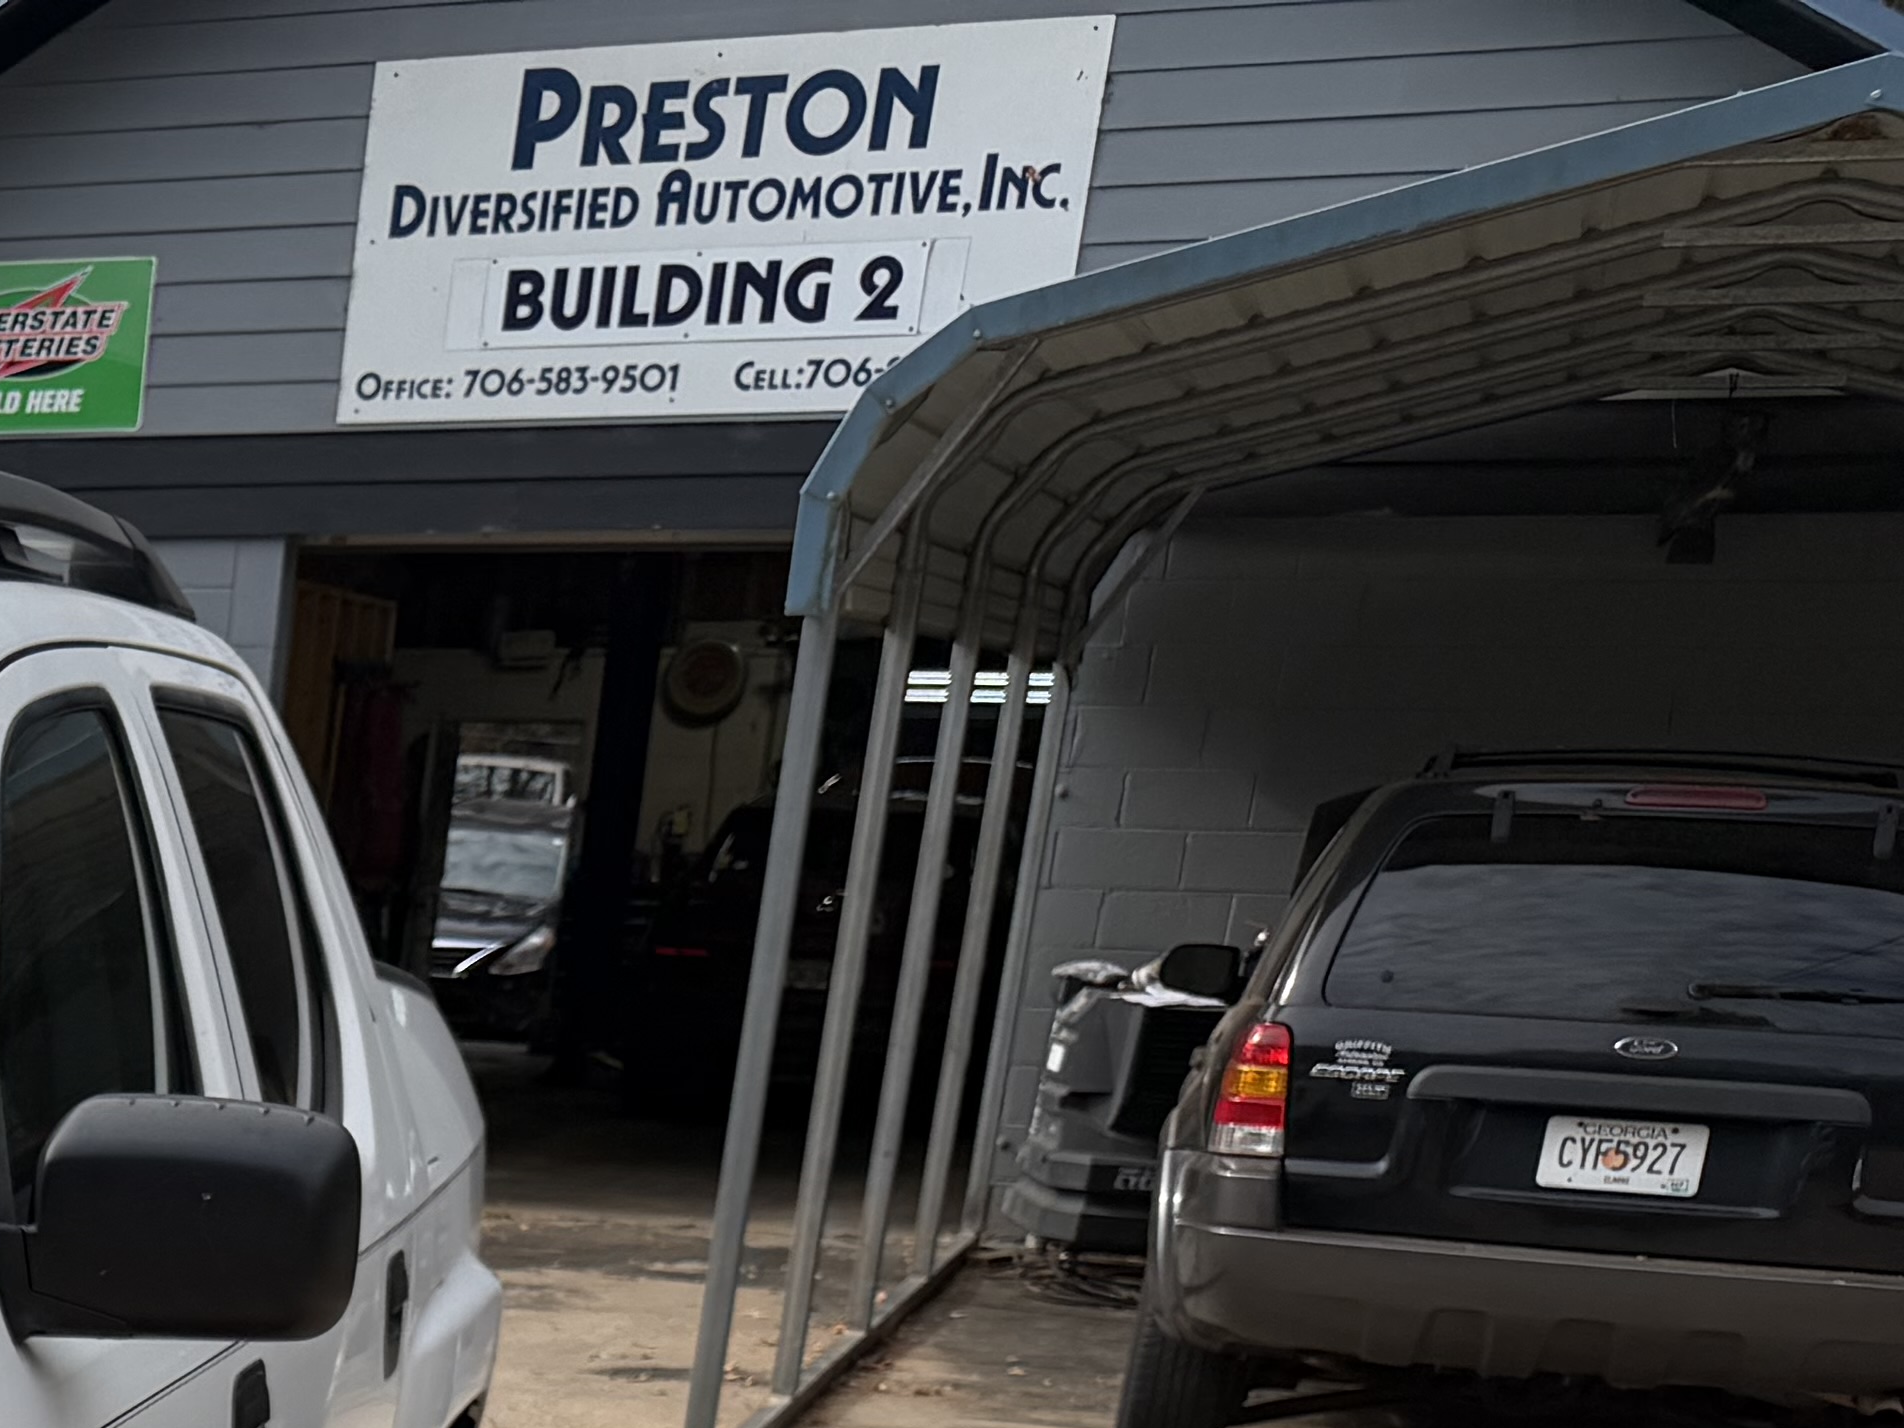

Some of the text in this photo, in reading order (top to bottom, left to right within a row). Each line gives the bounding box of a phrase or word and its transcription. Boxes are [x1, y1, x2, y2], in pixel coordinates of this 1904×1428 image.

[511, 64, 940, 171] PRESTON
[388, 152, 1070, 240] DIVERSIFIED AUTOMOTIVE, INC.
[501, 255, 905, 332] BUILDING 2
[25, 389, 85, 414] HERE
[356, 363, 681, 400] OFFICE: 706-583-9501
[1583, 1121, 1668, 1140] GEORGIA
[1558, 1136, 1687, 1176] CYF5927
